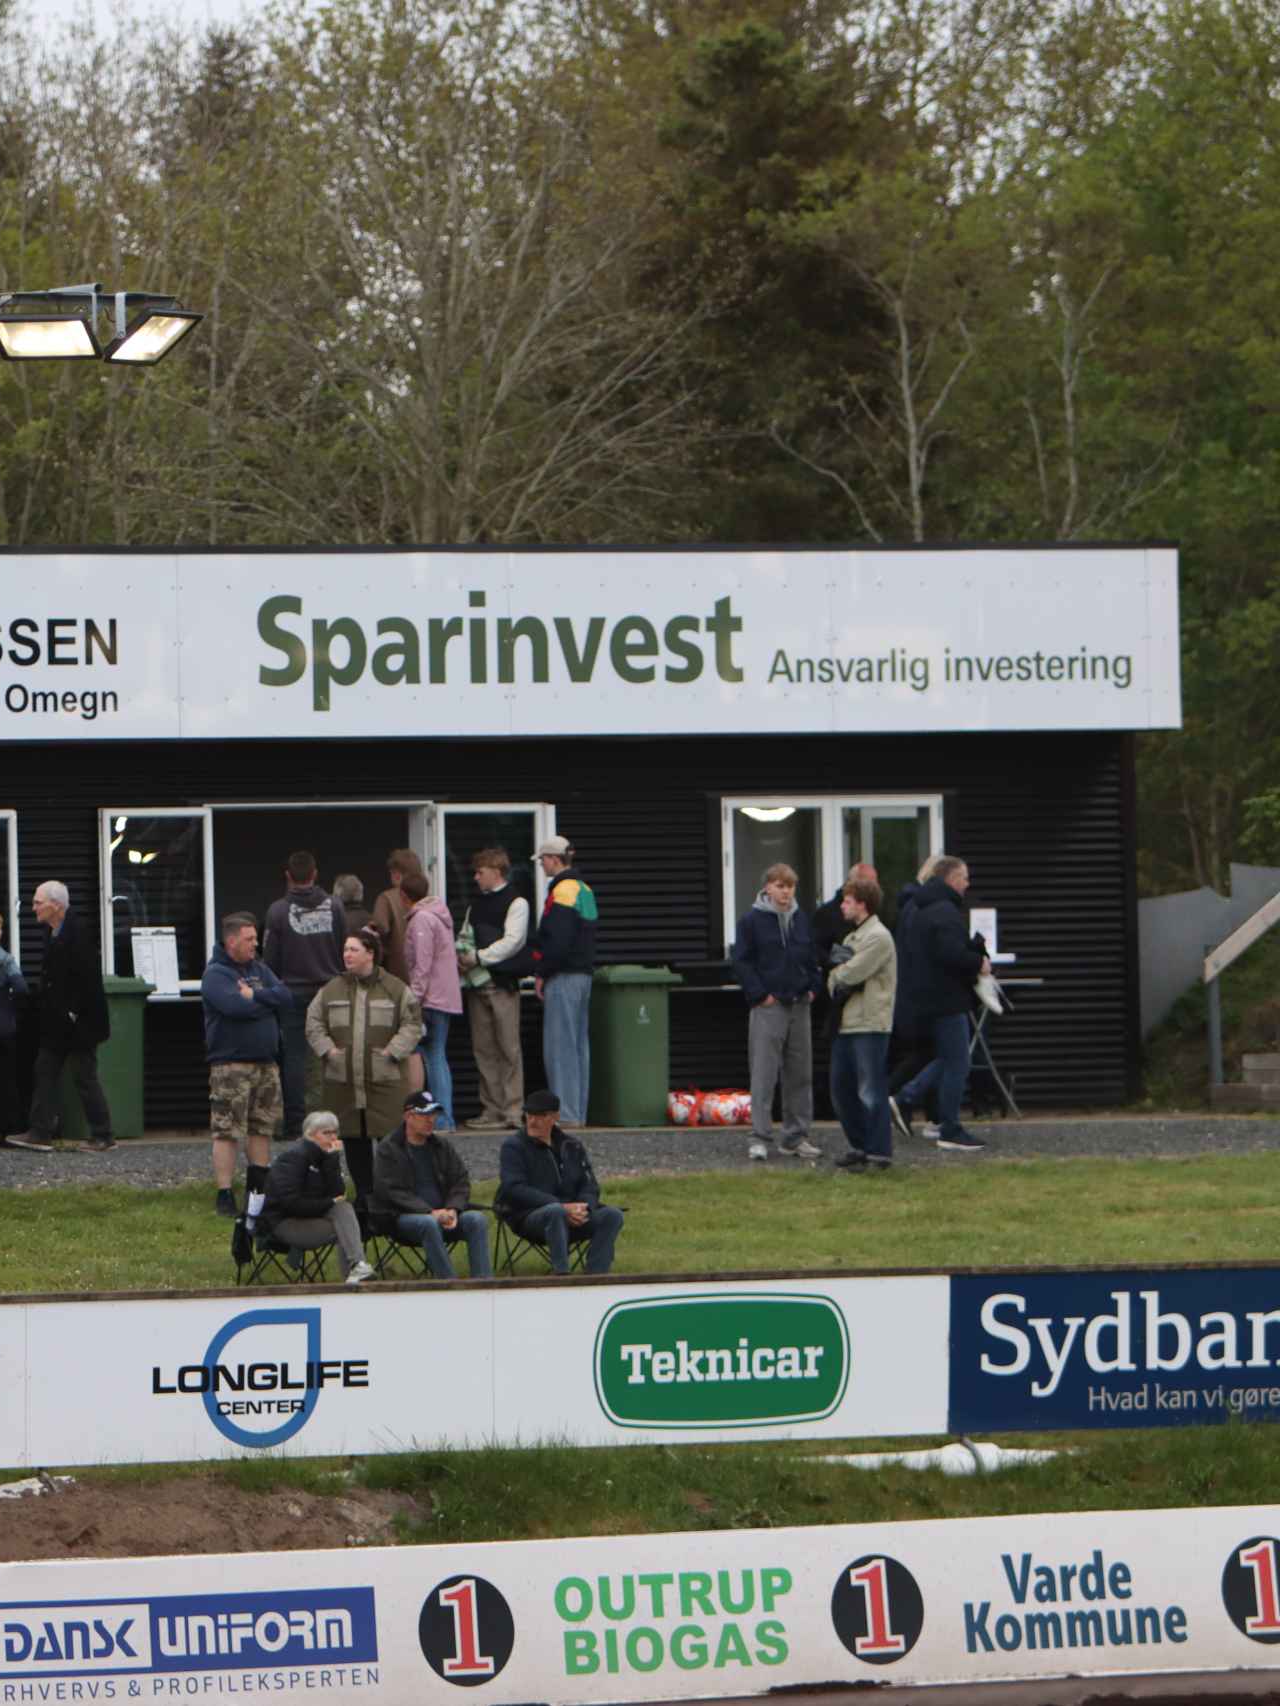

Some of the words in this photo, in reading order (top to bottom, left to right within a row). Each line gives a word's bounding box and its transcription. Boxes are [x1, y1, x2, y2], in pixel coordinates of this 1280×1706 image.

[255, 590, 744, 711] Sparinvest
[768, 649, 929, 691] Ansvarlig
[944, 646, 1133, 689] investering
[4, 684, 119, 720] Omegn
[152, 1360, 369, 1394] LONGLIFE
[621, 1337, 825, 1385] Teknicar
[216, 1399, 306, 1416] CENTER
[1088, 1383, 1149, 1412] Hvad
[1155, 1383, 1197, 1410] kan
[1202, 1384, 1223, 1408] vi
[554, 1567, 793, 1623] OUTRUP
[1001, 1549, 1133, 1604] Varde
[1239, 1540, 1280, 1634] 1
[438, 1578, 495, 1677] 1
[850, 1559, 906, 1655] 1
[963, 1601, 1188, 1653] Kommune
[4, 1618, 139, 1662] DANSK
[563, 1620, 790, 1676] BIOGAS
[127, 1679, 142, 1697] &
[152, 1667, 380, 1697] PROFILEKSPERTEN
